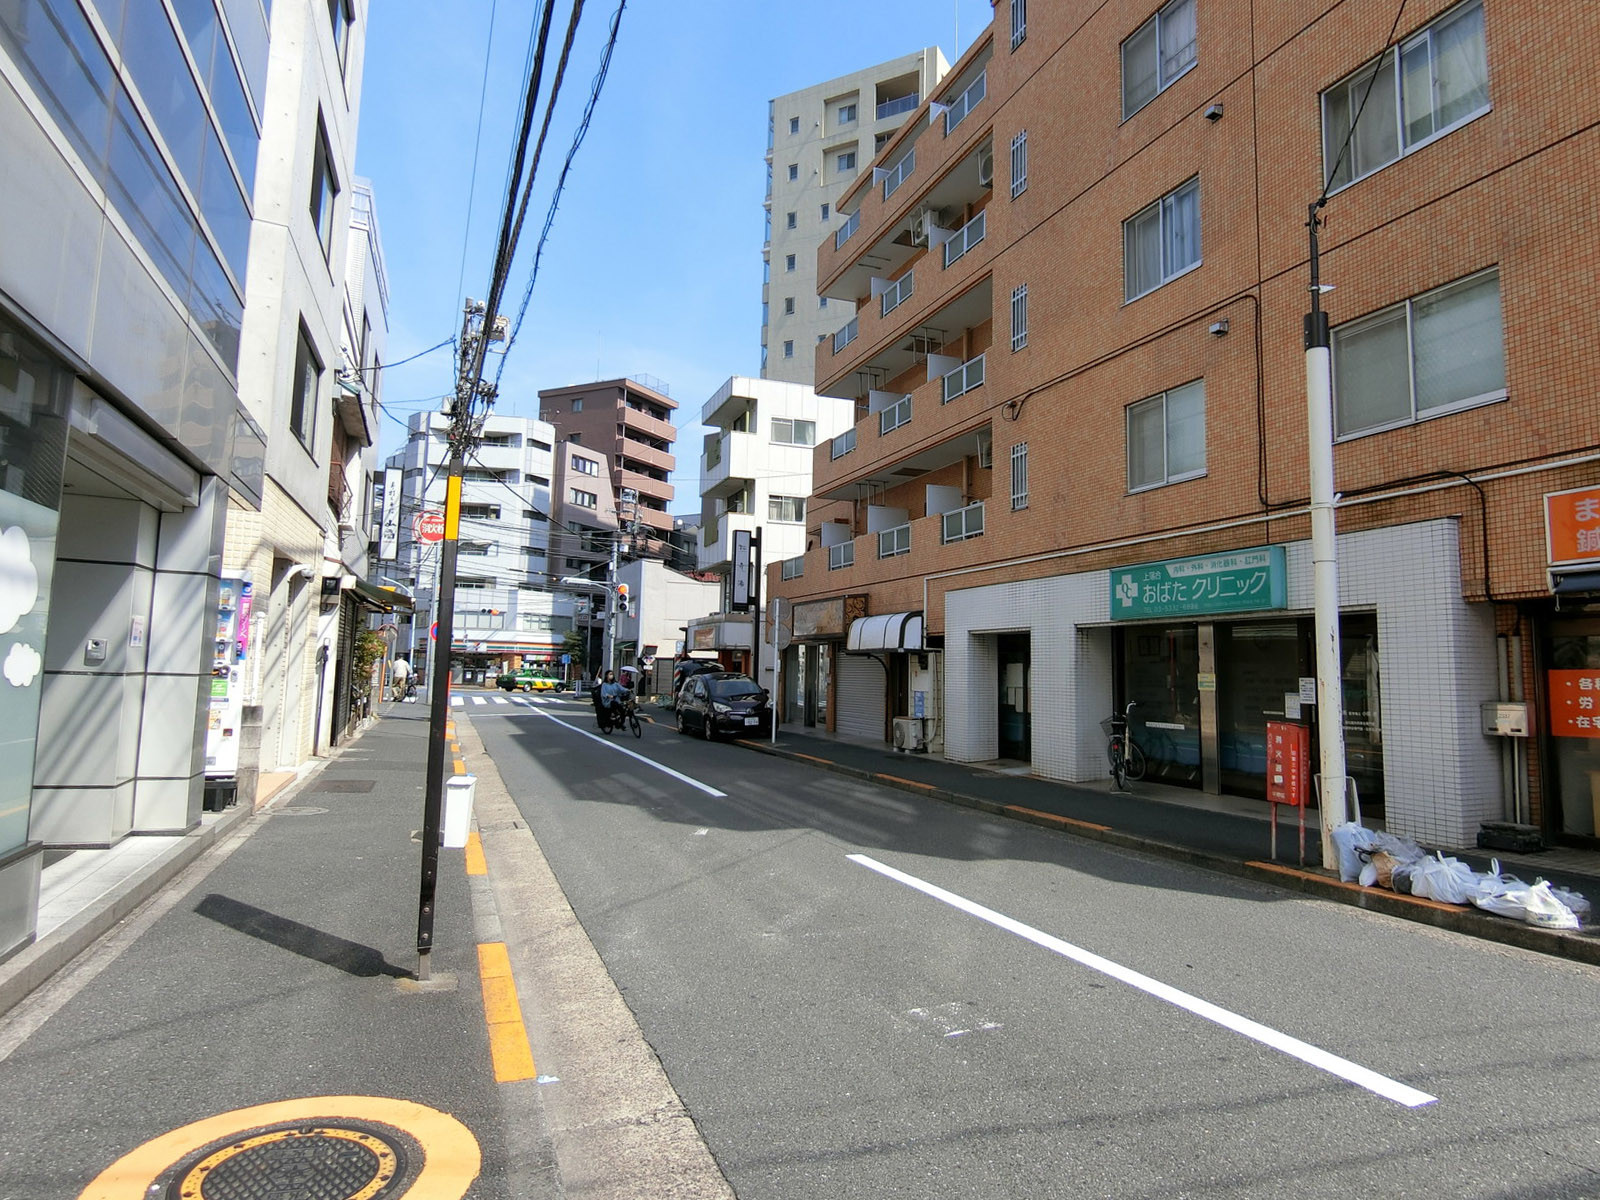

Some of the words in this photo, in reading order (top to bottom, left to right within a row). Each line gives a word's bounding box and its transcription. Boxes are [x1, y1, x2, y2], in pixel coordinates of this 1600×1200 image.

[1142, 581, 1187, 604] おばた
[1191, 571, 1267, 599] クリニック
